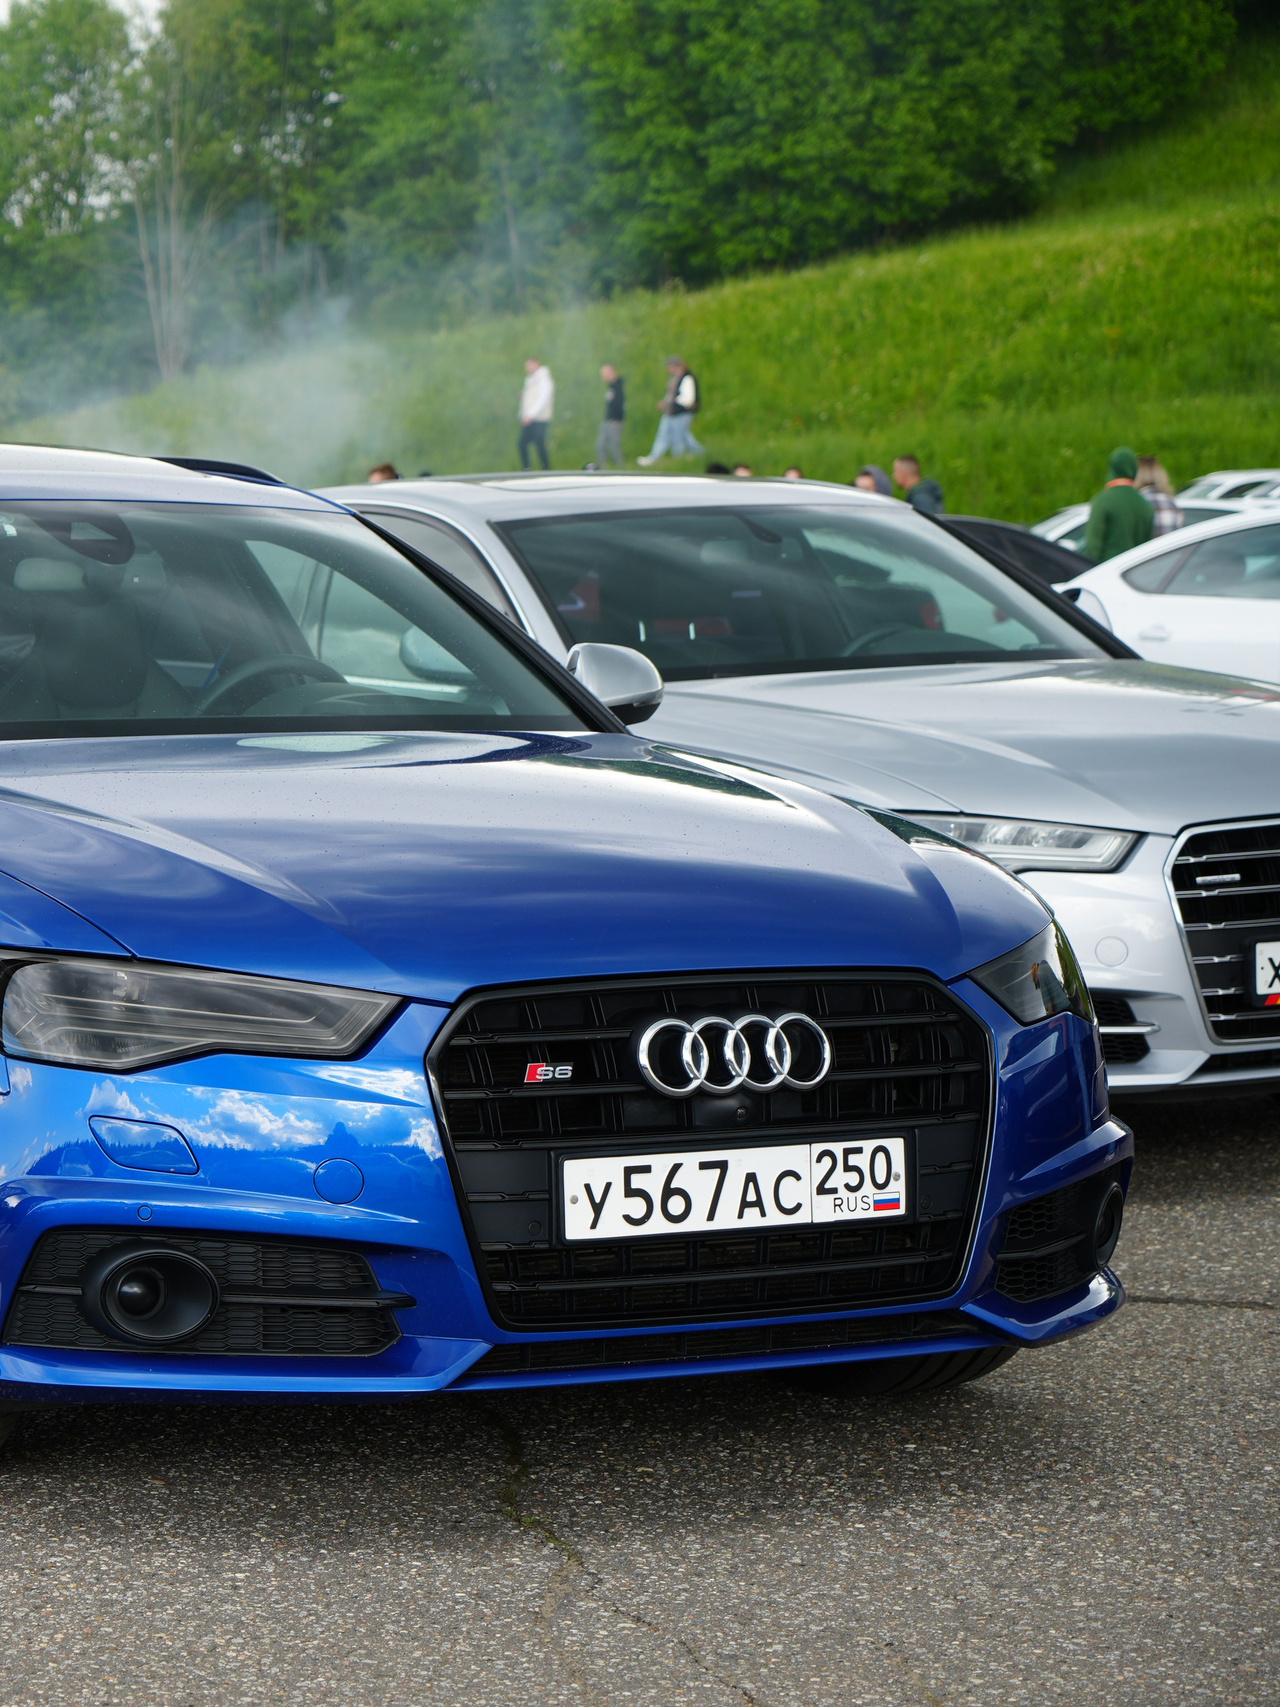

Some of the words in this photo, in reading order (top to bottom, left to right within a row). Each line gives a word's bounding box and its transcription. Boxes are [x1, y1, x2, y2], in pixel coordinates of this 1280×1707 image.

[536, 1066, 573, 1079] S6
[815, 1144, 893, 1196] 250
[833, 1195, 871, 1214] RUS
